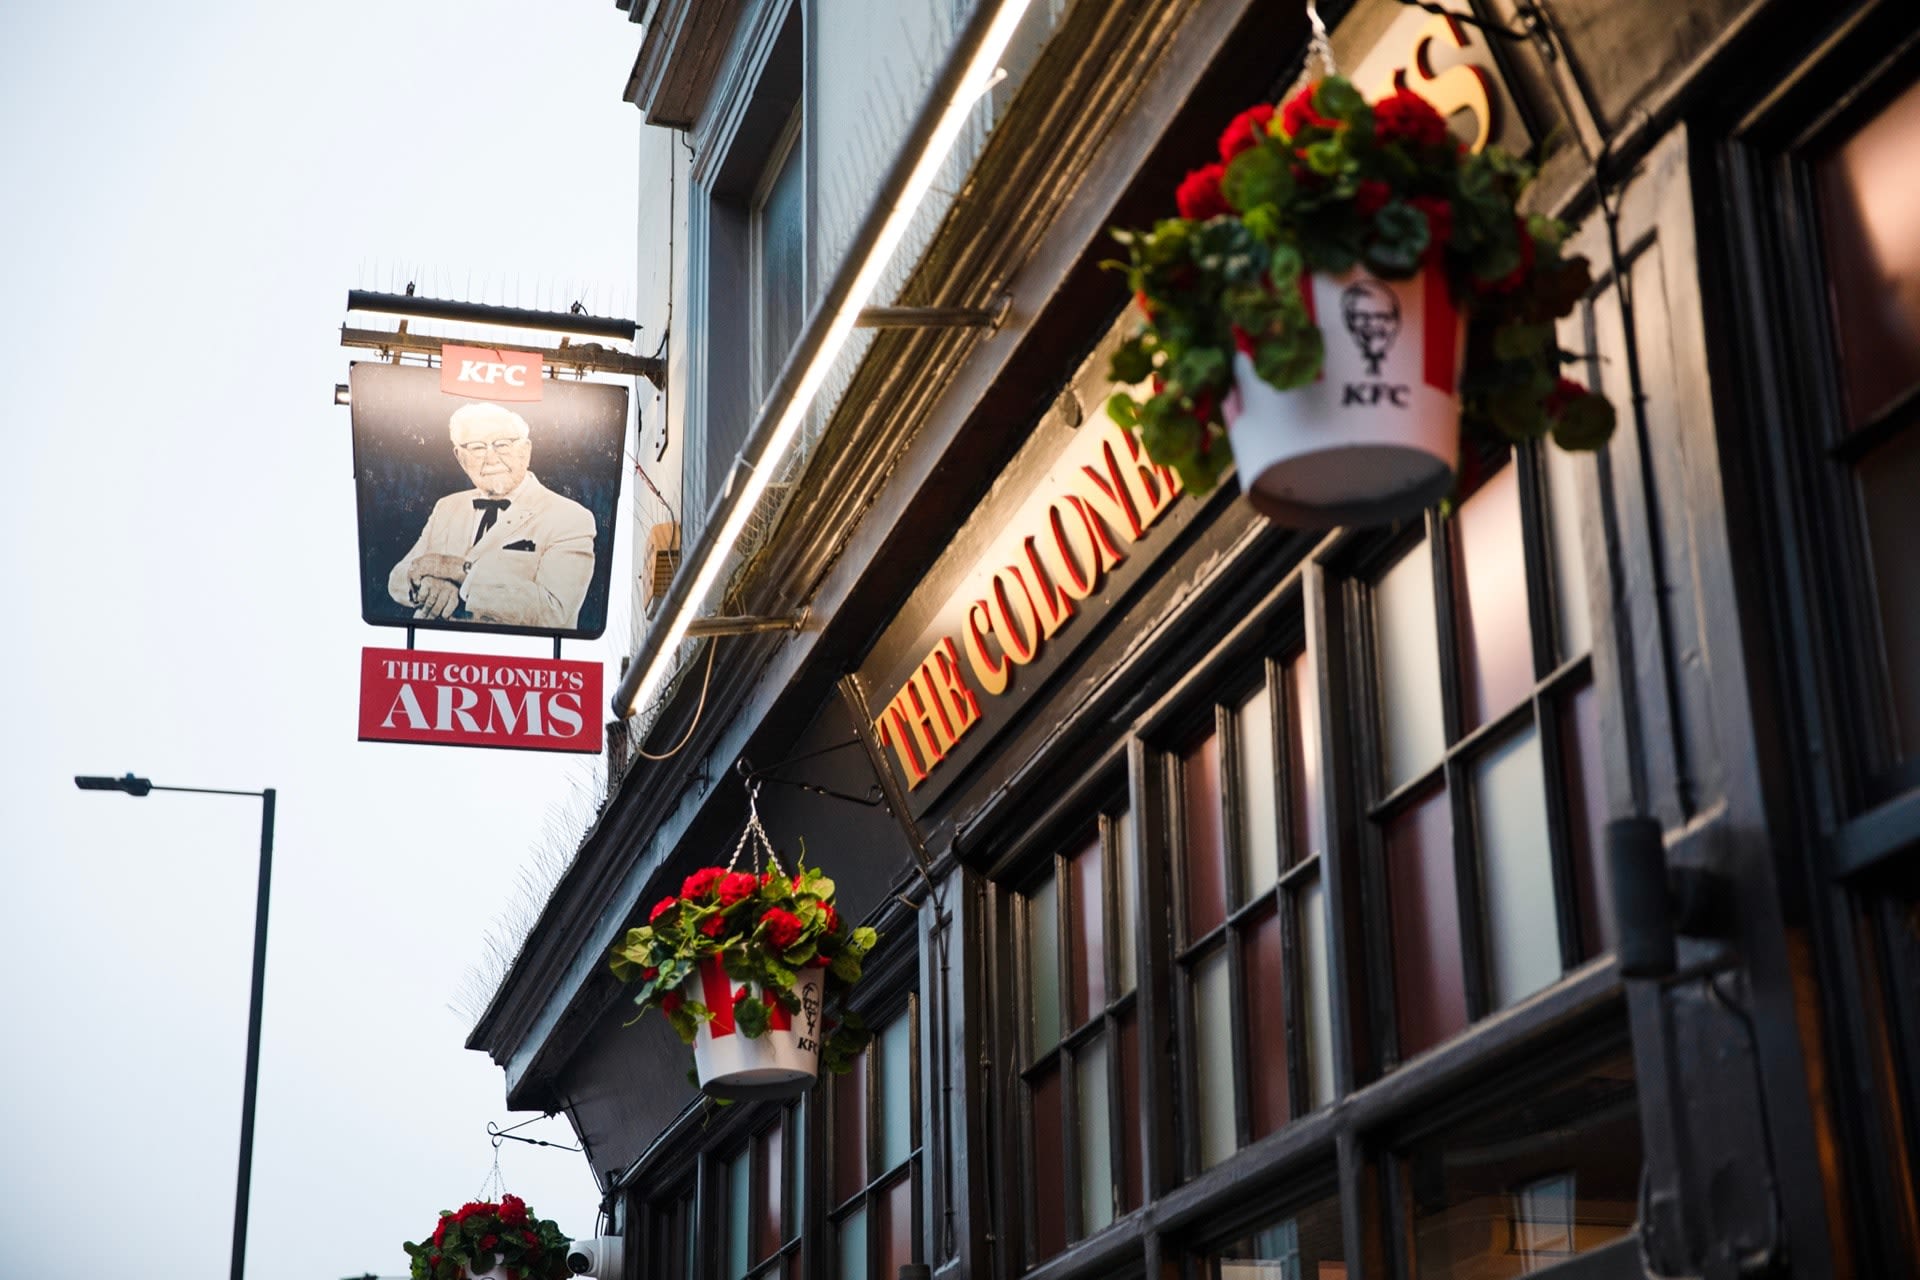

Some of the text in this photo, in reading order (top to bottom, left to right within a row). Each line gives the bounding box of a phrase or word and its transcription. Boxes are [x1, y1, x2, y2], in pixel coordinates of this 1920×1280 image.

[457, 360, 527, 387] KFC
[1342, 383, 1410, 409] KFC
[874, 424, 1184, 791] THE COLONE
[382, 660, 583, 690] THE COLONEL'S
[380, 683, 583, 739] ARMS
